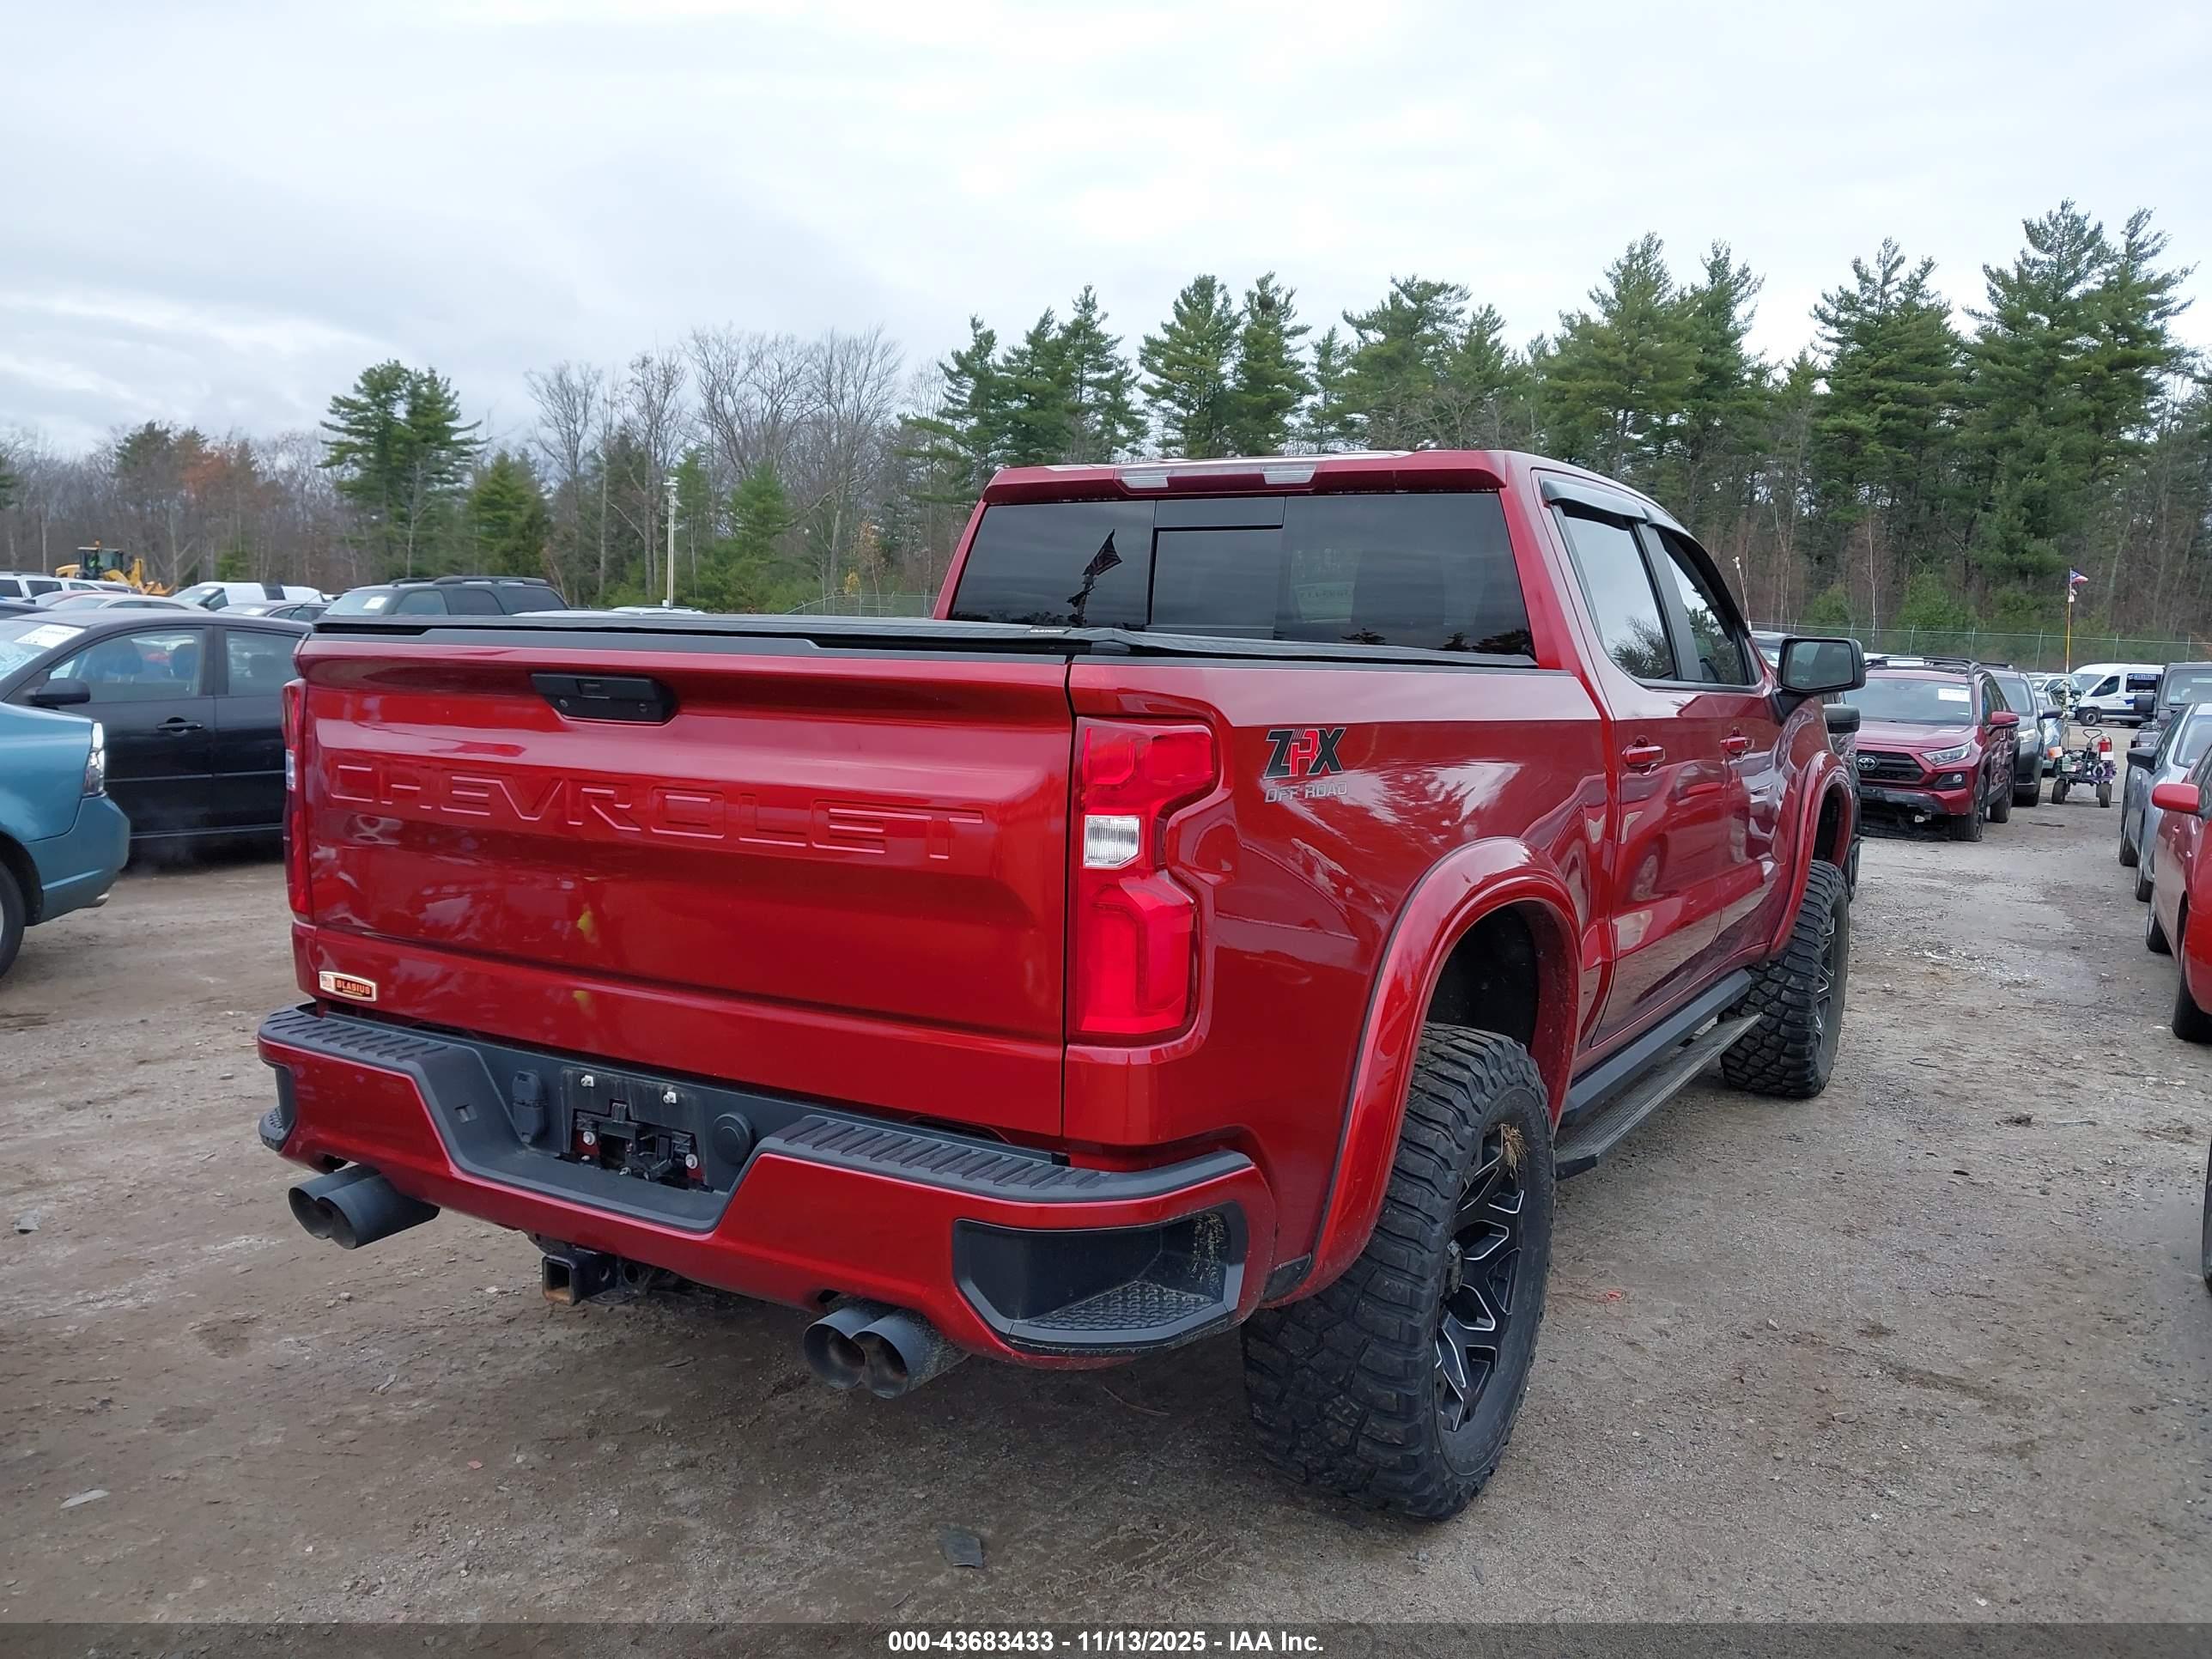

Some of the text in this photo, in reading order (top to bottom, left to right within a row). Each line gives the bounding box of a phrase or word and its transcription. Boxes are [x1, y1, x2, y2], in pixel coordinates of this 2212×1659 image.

[1265, 782, 1347, 803] OFF ROAD
[329, 762, 985, 860] CHEVROLET
[336, 979, 371, 994] BLASIUS
